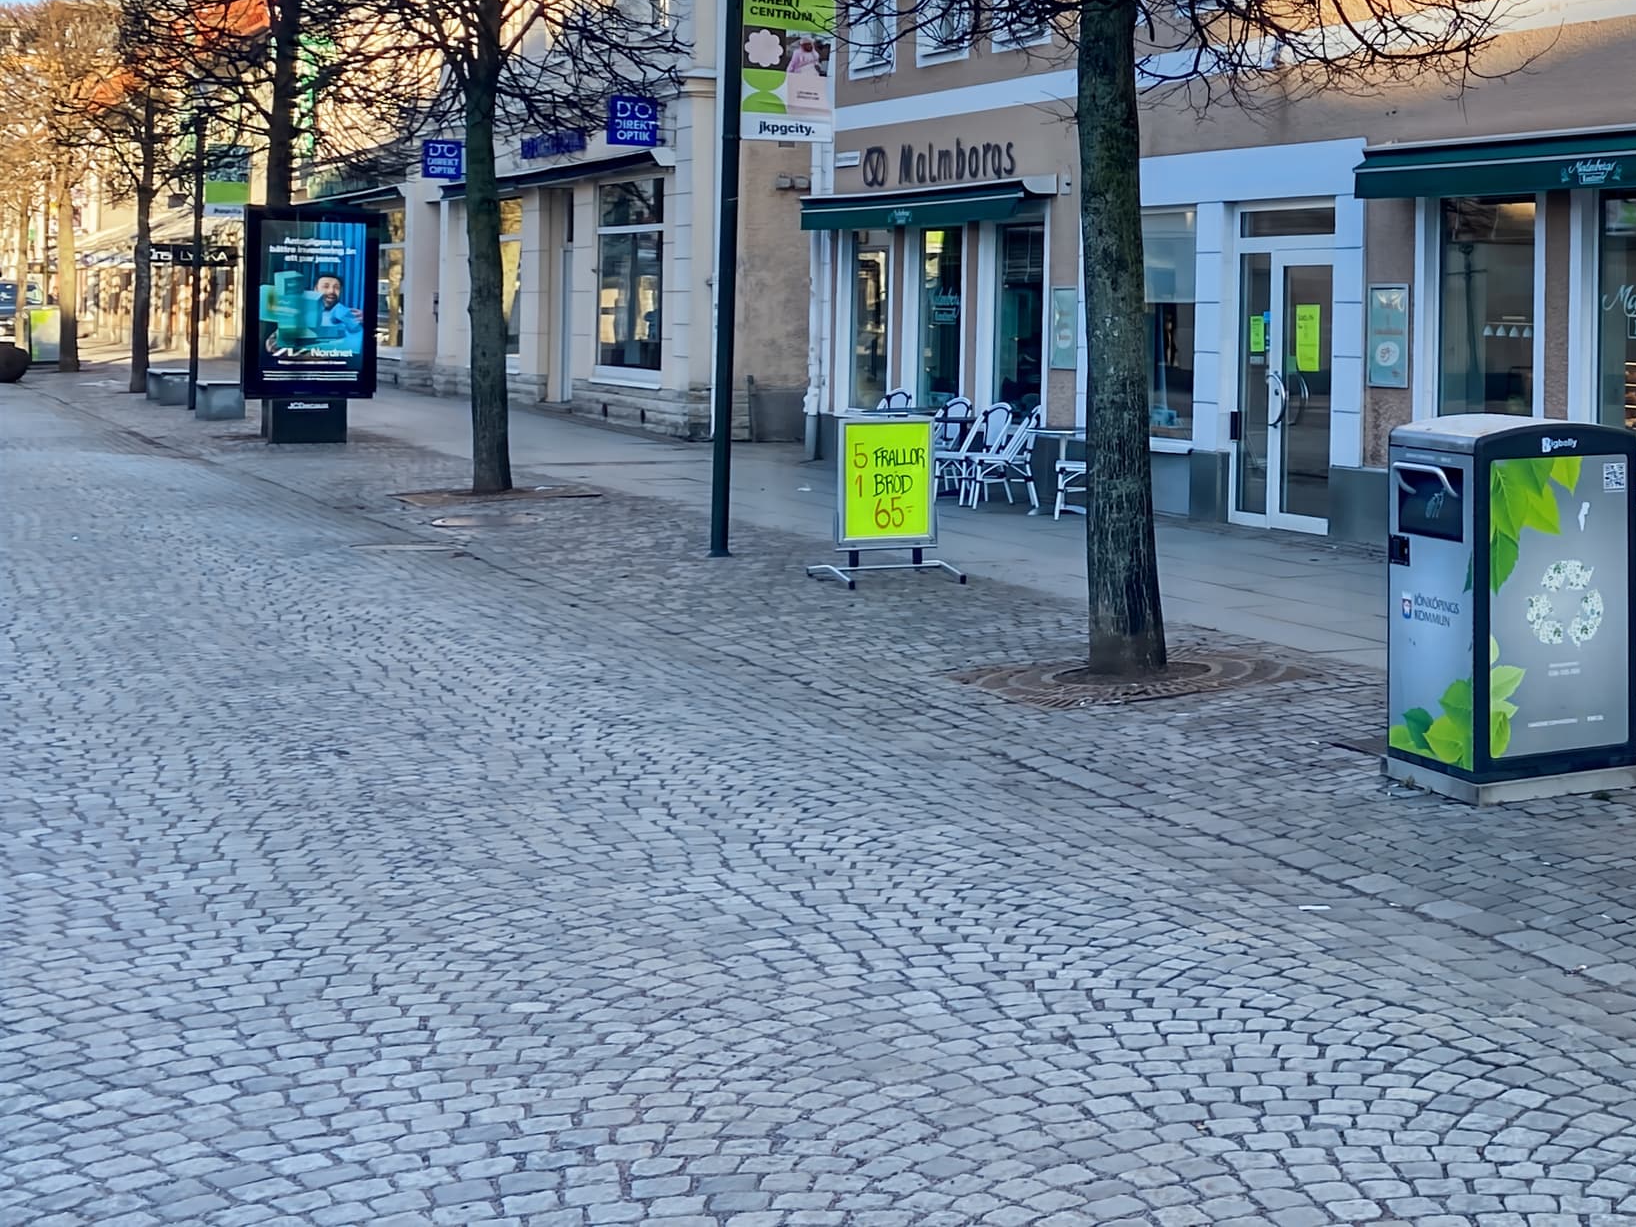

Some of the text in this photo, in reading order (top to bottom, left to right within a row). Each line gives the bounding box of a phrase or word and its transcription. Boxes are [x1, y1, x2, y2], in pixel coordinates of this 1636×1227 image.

[615, 119, 655, 130] DIREKT
[759, 120, 815, 136] jkpgcity.
[616, 130, 651, 141] OPTIK
[898, 138, 1016, 185] Malmborgs
[310, 347, 353, 357] Nordnet
[853, 442, 926, 470] 5 FRALLOR
[855, 474, 863, 498] 1
